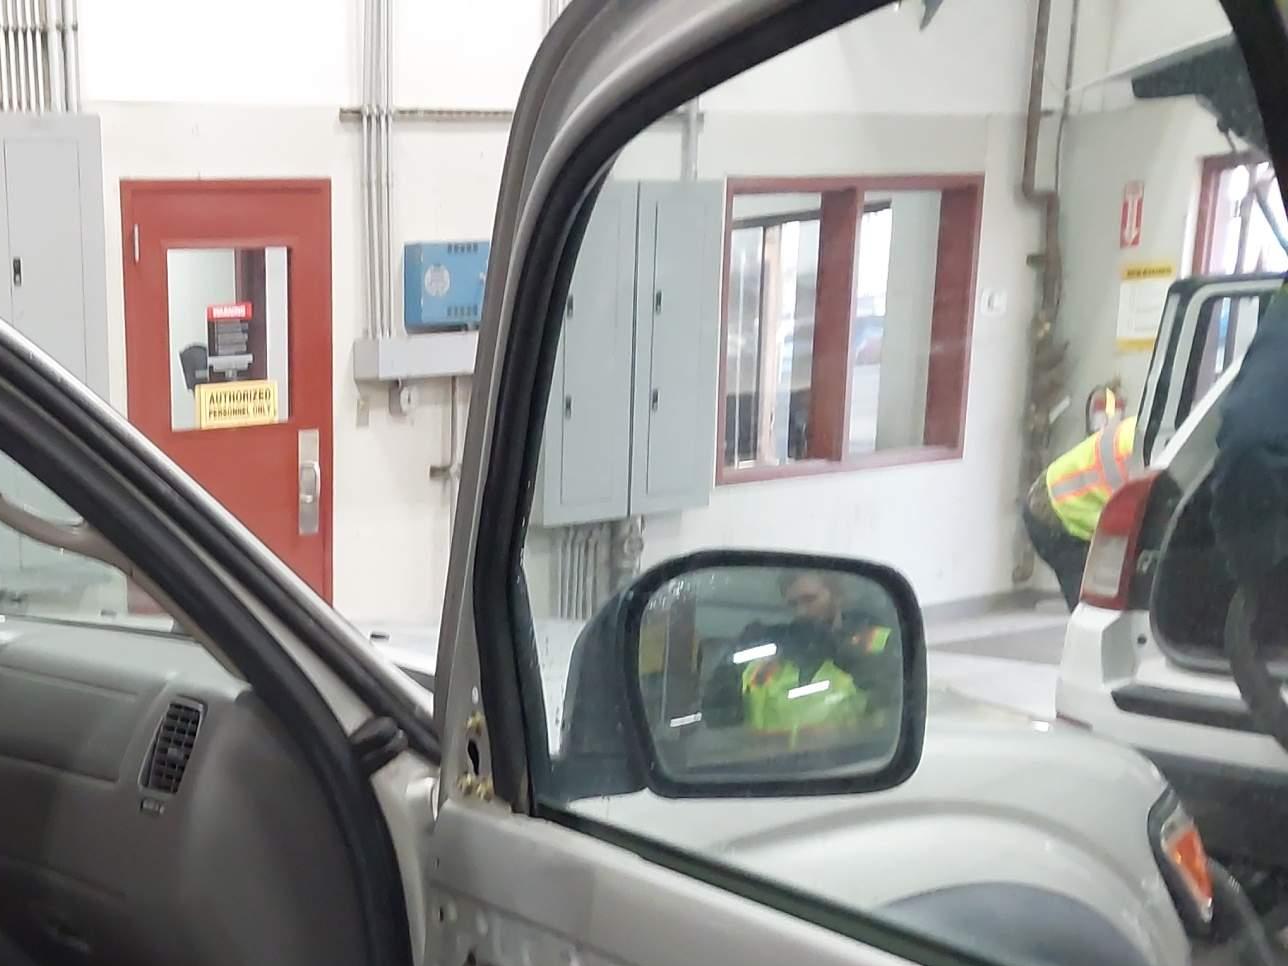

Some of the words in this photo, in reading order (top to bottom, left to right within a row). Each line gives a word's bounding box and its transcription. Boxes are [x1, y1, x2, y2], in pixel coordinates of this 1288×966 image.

[209, 388, 271, 404] AUTHORIZED
[208, 407, 249, 418] PERSONNEL
[253, 404, 270, 416] ONLY
